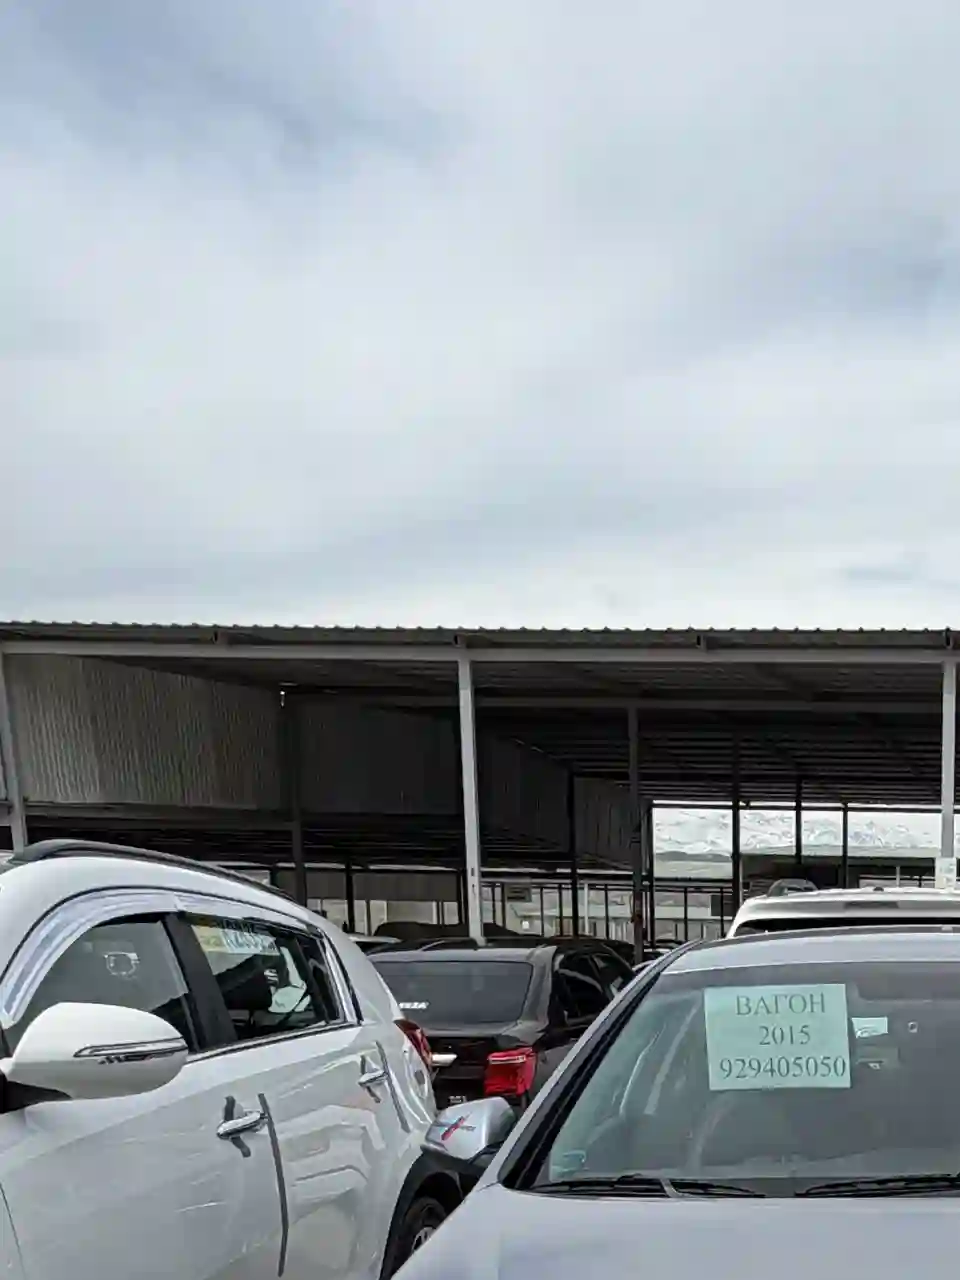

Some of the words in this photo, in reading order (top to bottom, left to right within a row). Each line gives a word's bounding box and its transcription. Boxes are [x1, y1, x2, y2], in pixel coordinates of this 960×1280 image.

[736, 992, 826, 1016] ВАГОН
[759, 1024, 811, 1046] 2015
[720, 1056, 846, 1079] 929405050
